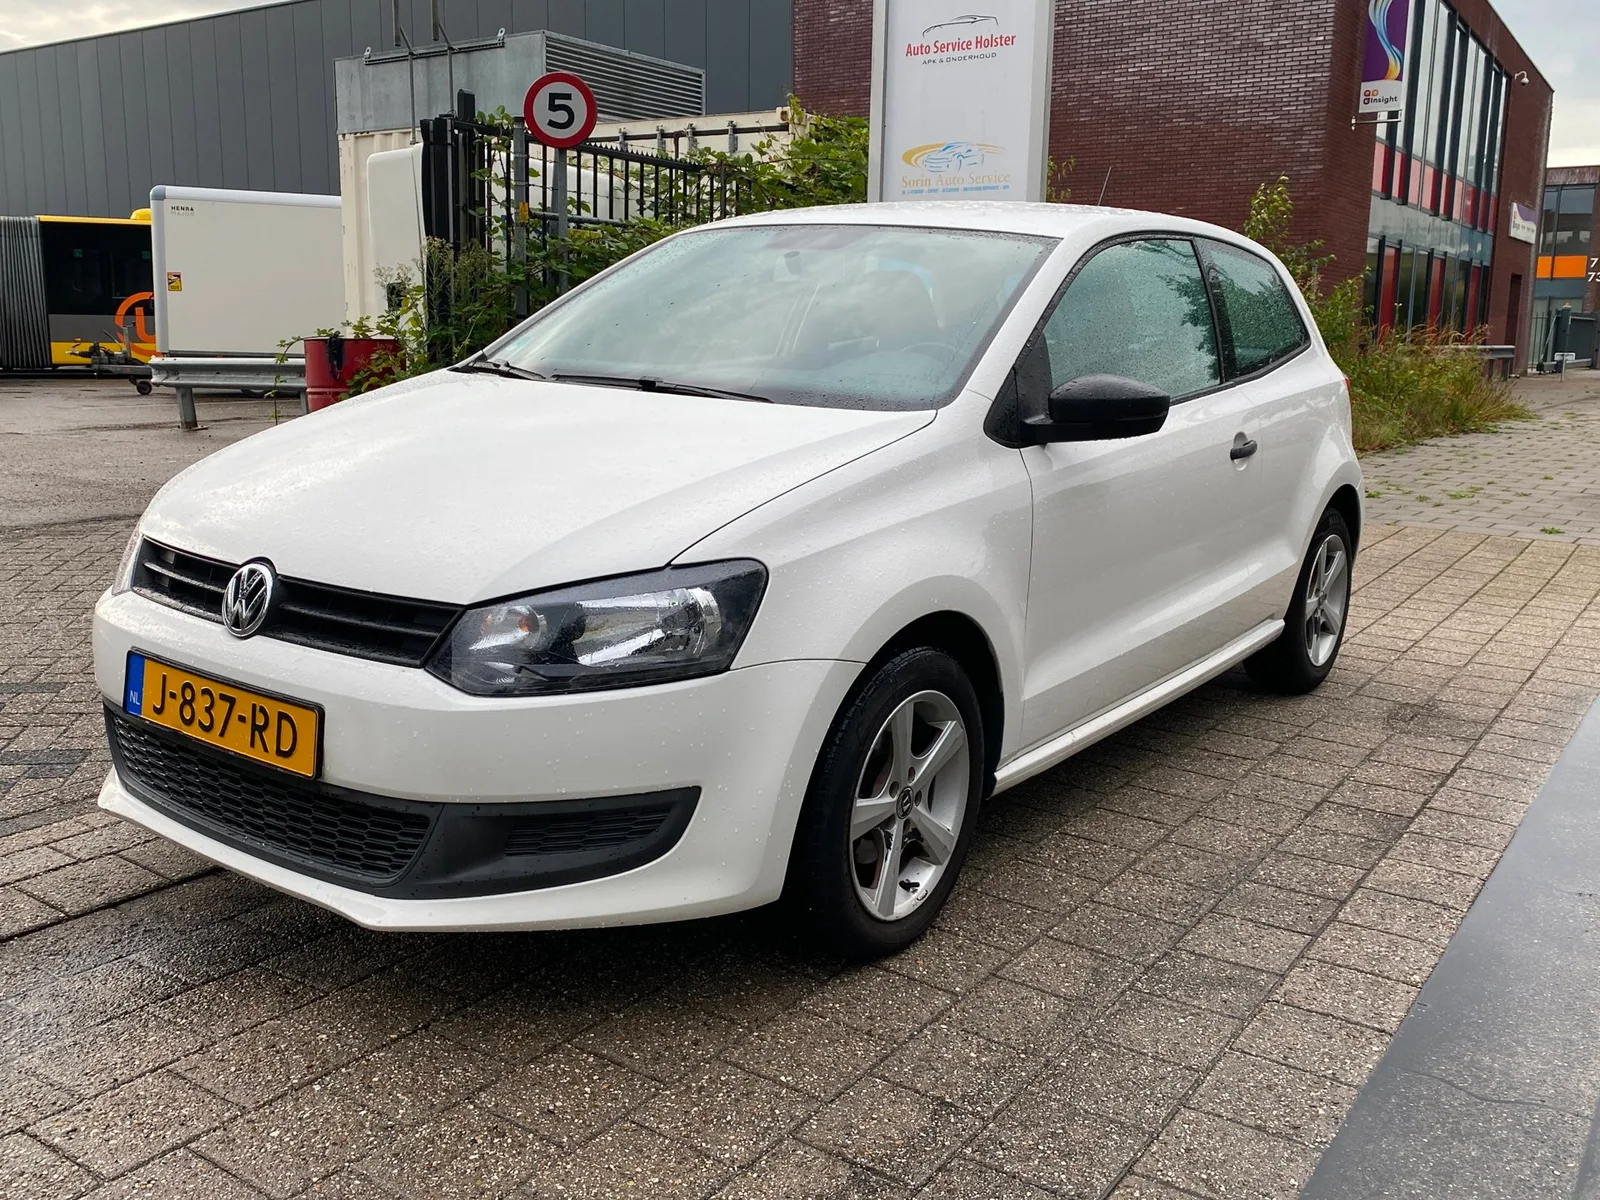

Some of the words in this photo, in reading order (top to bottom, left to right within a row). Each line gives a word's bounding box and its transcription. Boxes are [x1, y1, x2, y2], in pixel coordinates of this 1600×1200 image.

[905, 43, 931, 57] Auto
[933, 37, 973, 54] Service
[975, 34, 1017, 49] Holster
[945, 52, 997, 63] ONDERHOUD
[1370, 95, 1398, 105] Insight
[546, 92, 575, 130] 5
[901, 173, 931, 188] Sorin
[936, 174, 964, 186] Auto
[967, 170, 1011, 185] Service
[129, 689, 141, 706] NL
[152, 672, 298, 759] J-837-RD
